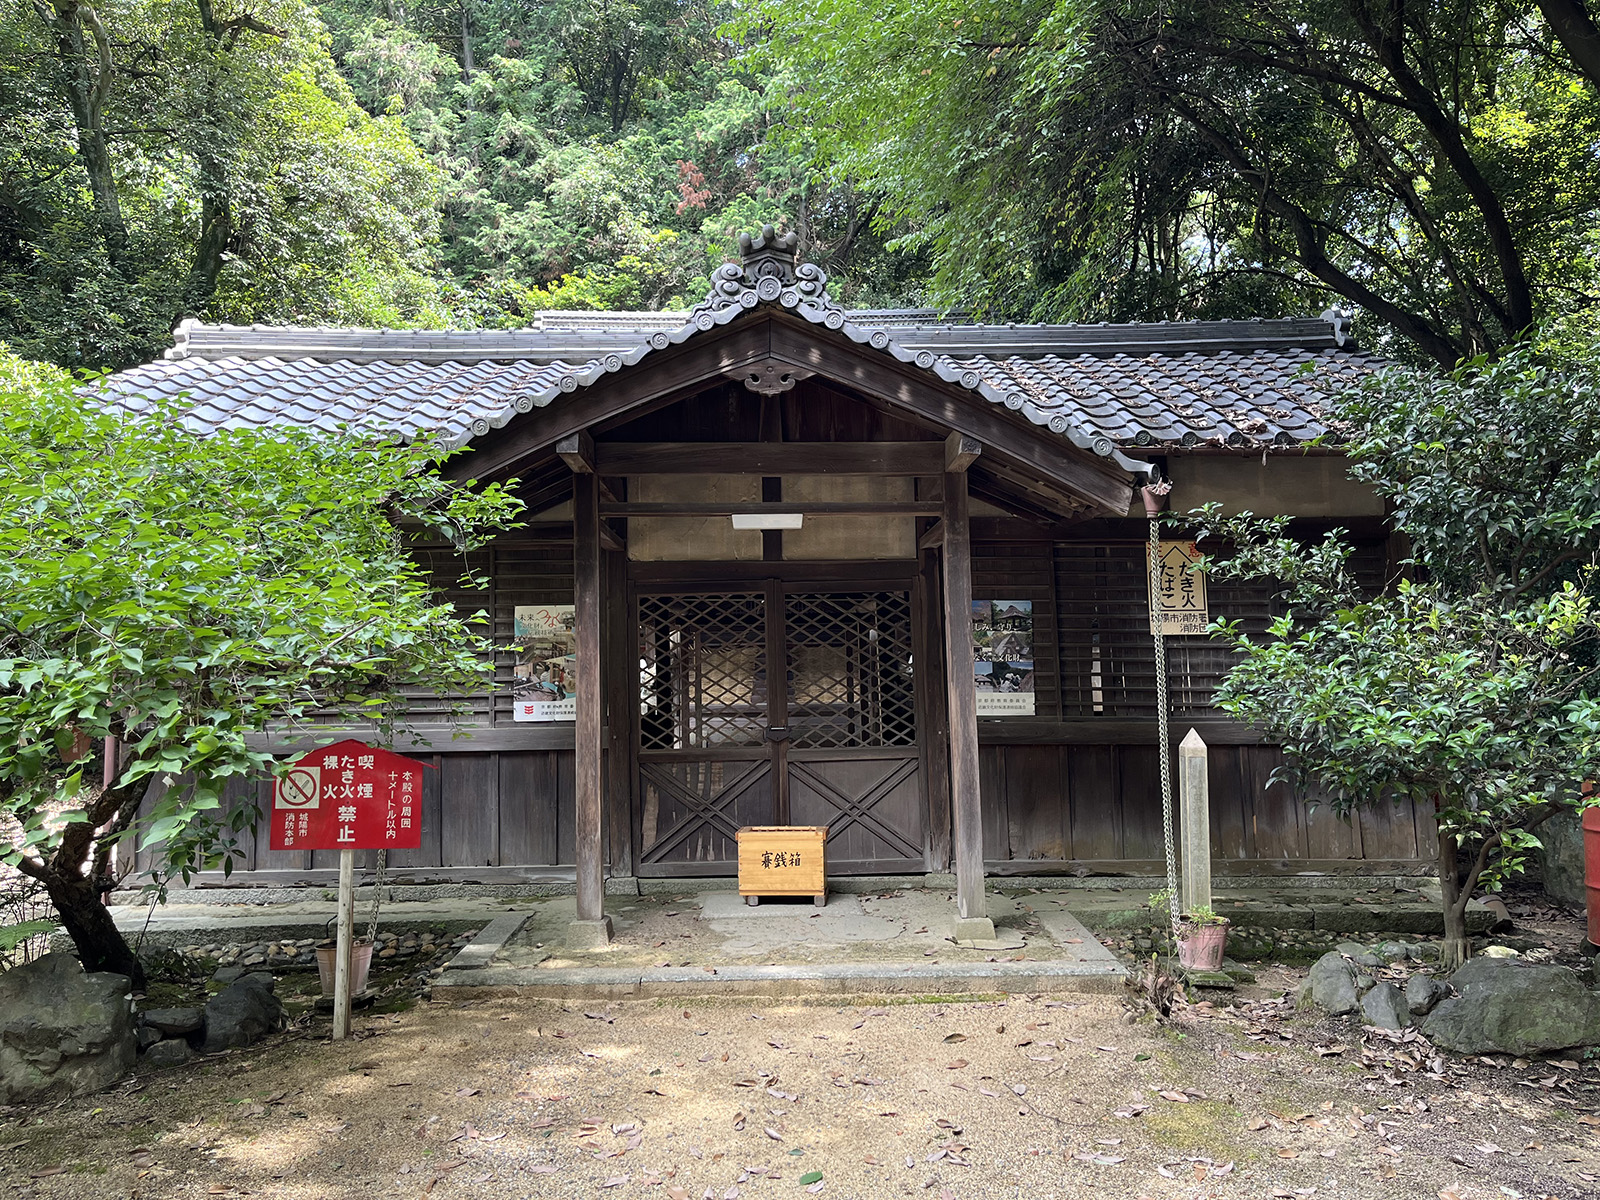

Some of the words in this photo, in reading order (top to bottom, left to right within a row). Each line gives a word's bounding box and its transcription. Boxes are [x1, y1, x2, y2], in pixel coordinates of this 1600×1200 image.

[1159, 562, 1176, 608] たばこ
[1179, 561, 1196, 608] たき火
[323, 755, 339, 799] 裸火
[339, 755, 356, 798] たき火
[357, 755, 375, 798] 喫煙
[385, 771, 398, 839] 十メートル以内
[400, 770, 413, 828] 本殿の周囲
[284, 813, 295, 846] 消防本部
[298, 812, 309, 837] 城陽市
[337, 805, 357, 842] 禁止
[761, 850, 801, 870] 賽銭箱
